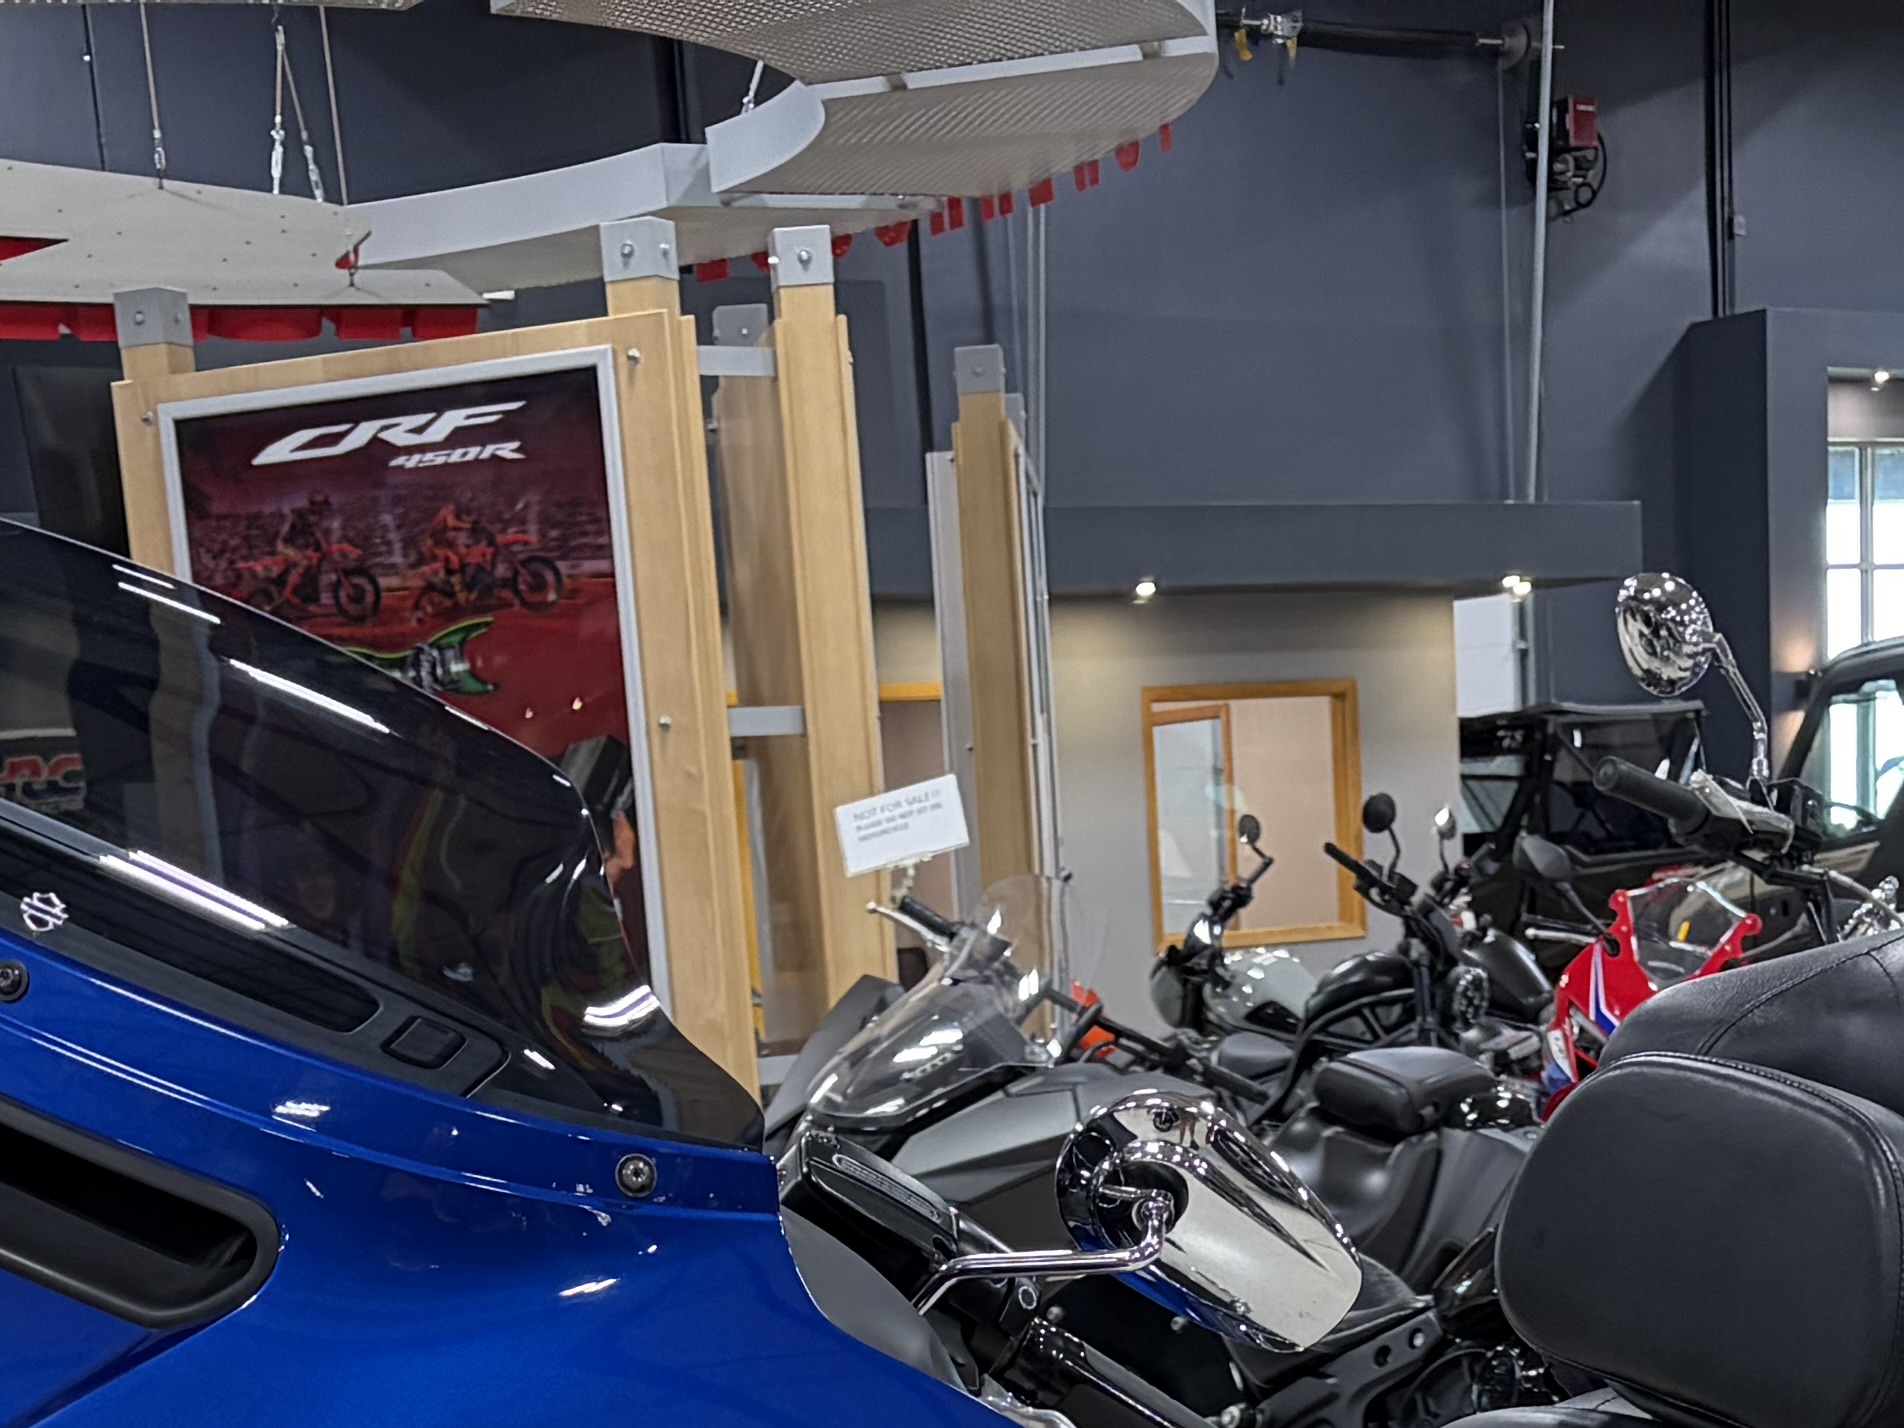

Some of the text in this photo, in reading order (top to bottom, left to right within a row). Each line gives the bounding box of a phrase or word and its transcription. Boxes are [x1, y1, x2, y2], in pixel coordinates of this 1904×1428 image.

[251, 400, 527, 466] CRF
[388, 440, 527, 468] 450R
[879, 800, 902, 814] FOR
